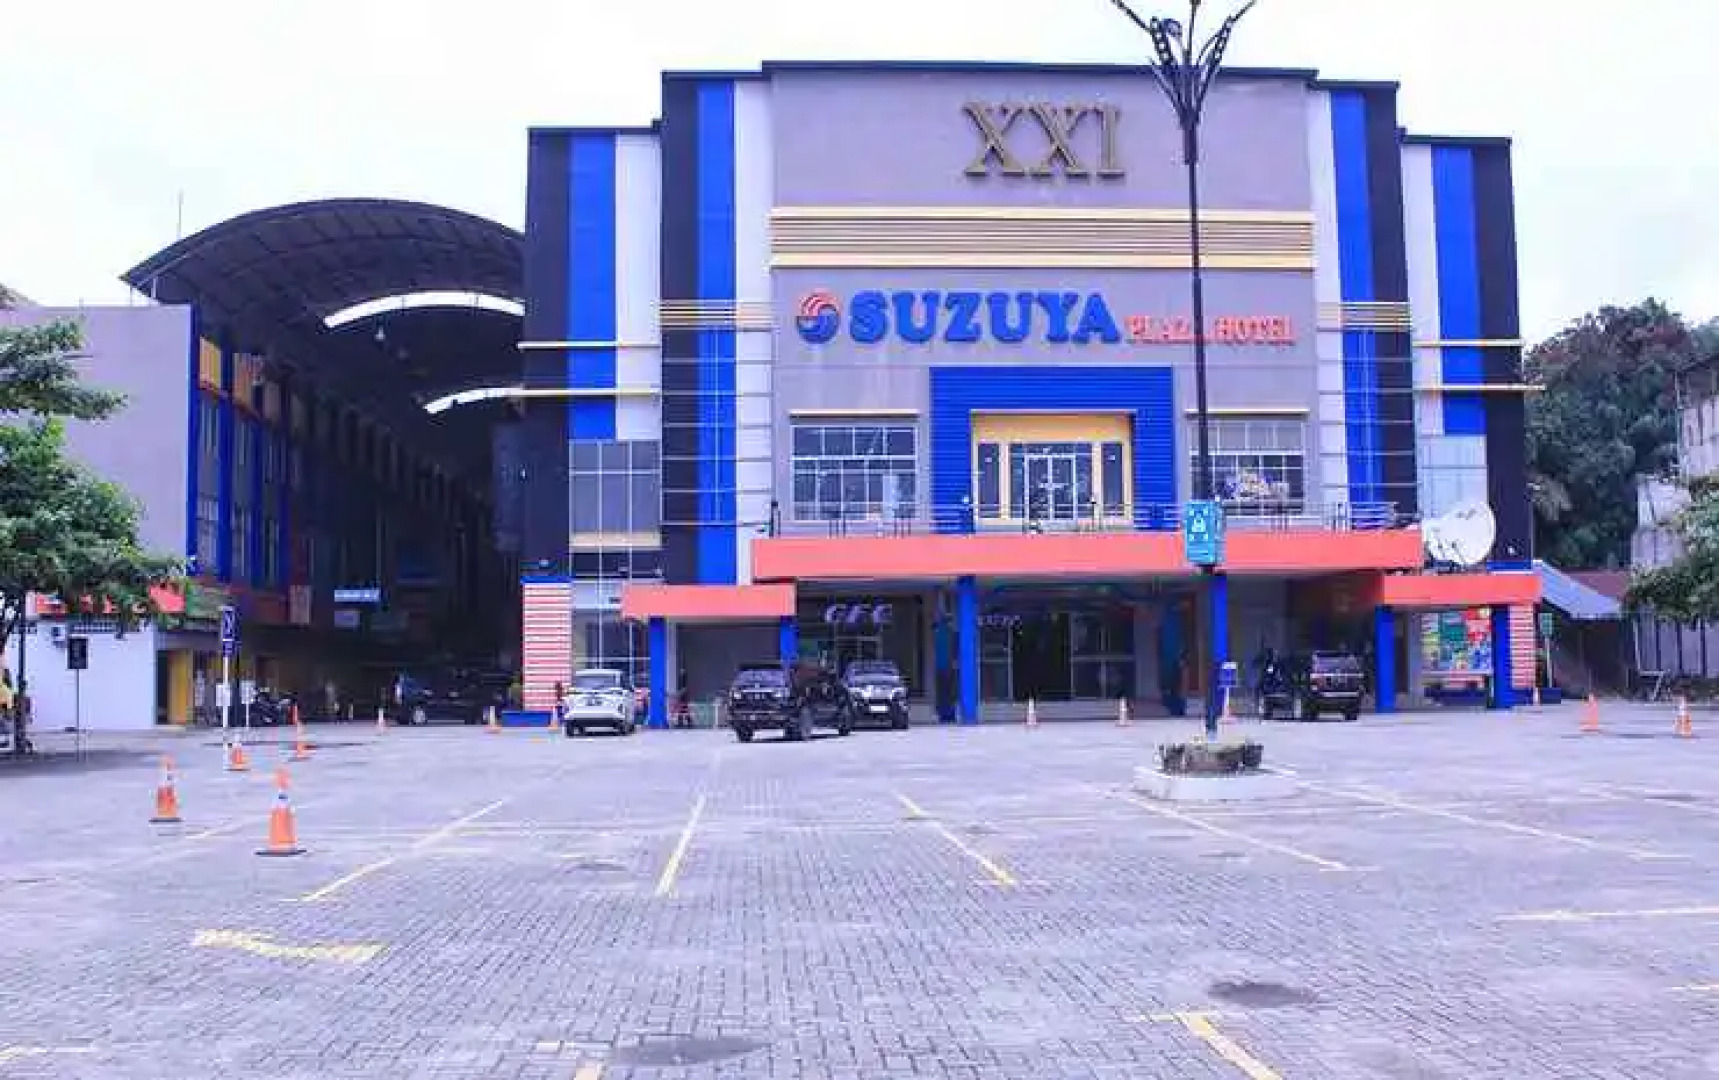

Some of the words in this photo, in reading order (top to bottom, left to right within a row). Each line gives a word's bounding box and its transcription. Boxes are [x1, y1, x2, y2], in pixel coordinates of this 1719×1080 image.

[963, 101, 1126, 180] XXI
[848, 290, 1121, 346] SUZUYA
[1215, 315, 1296, 346] HOTEL
